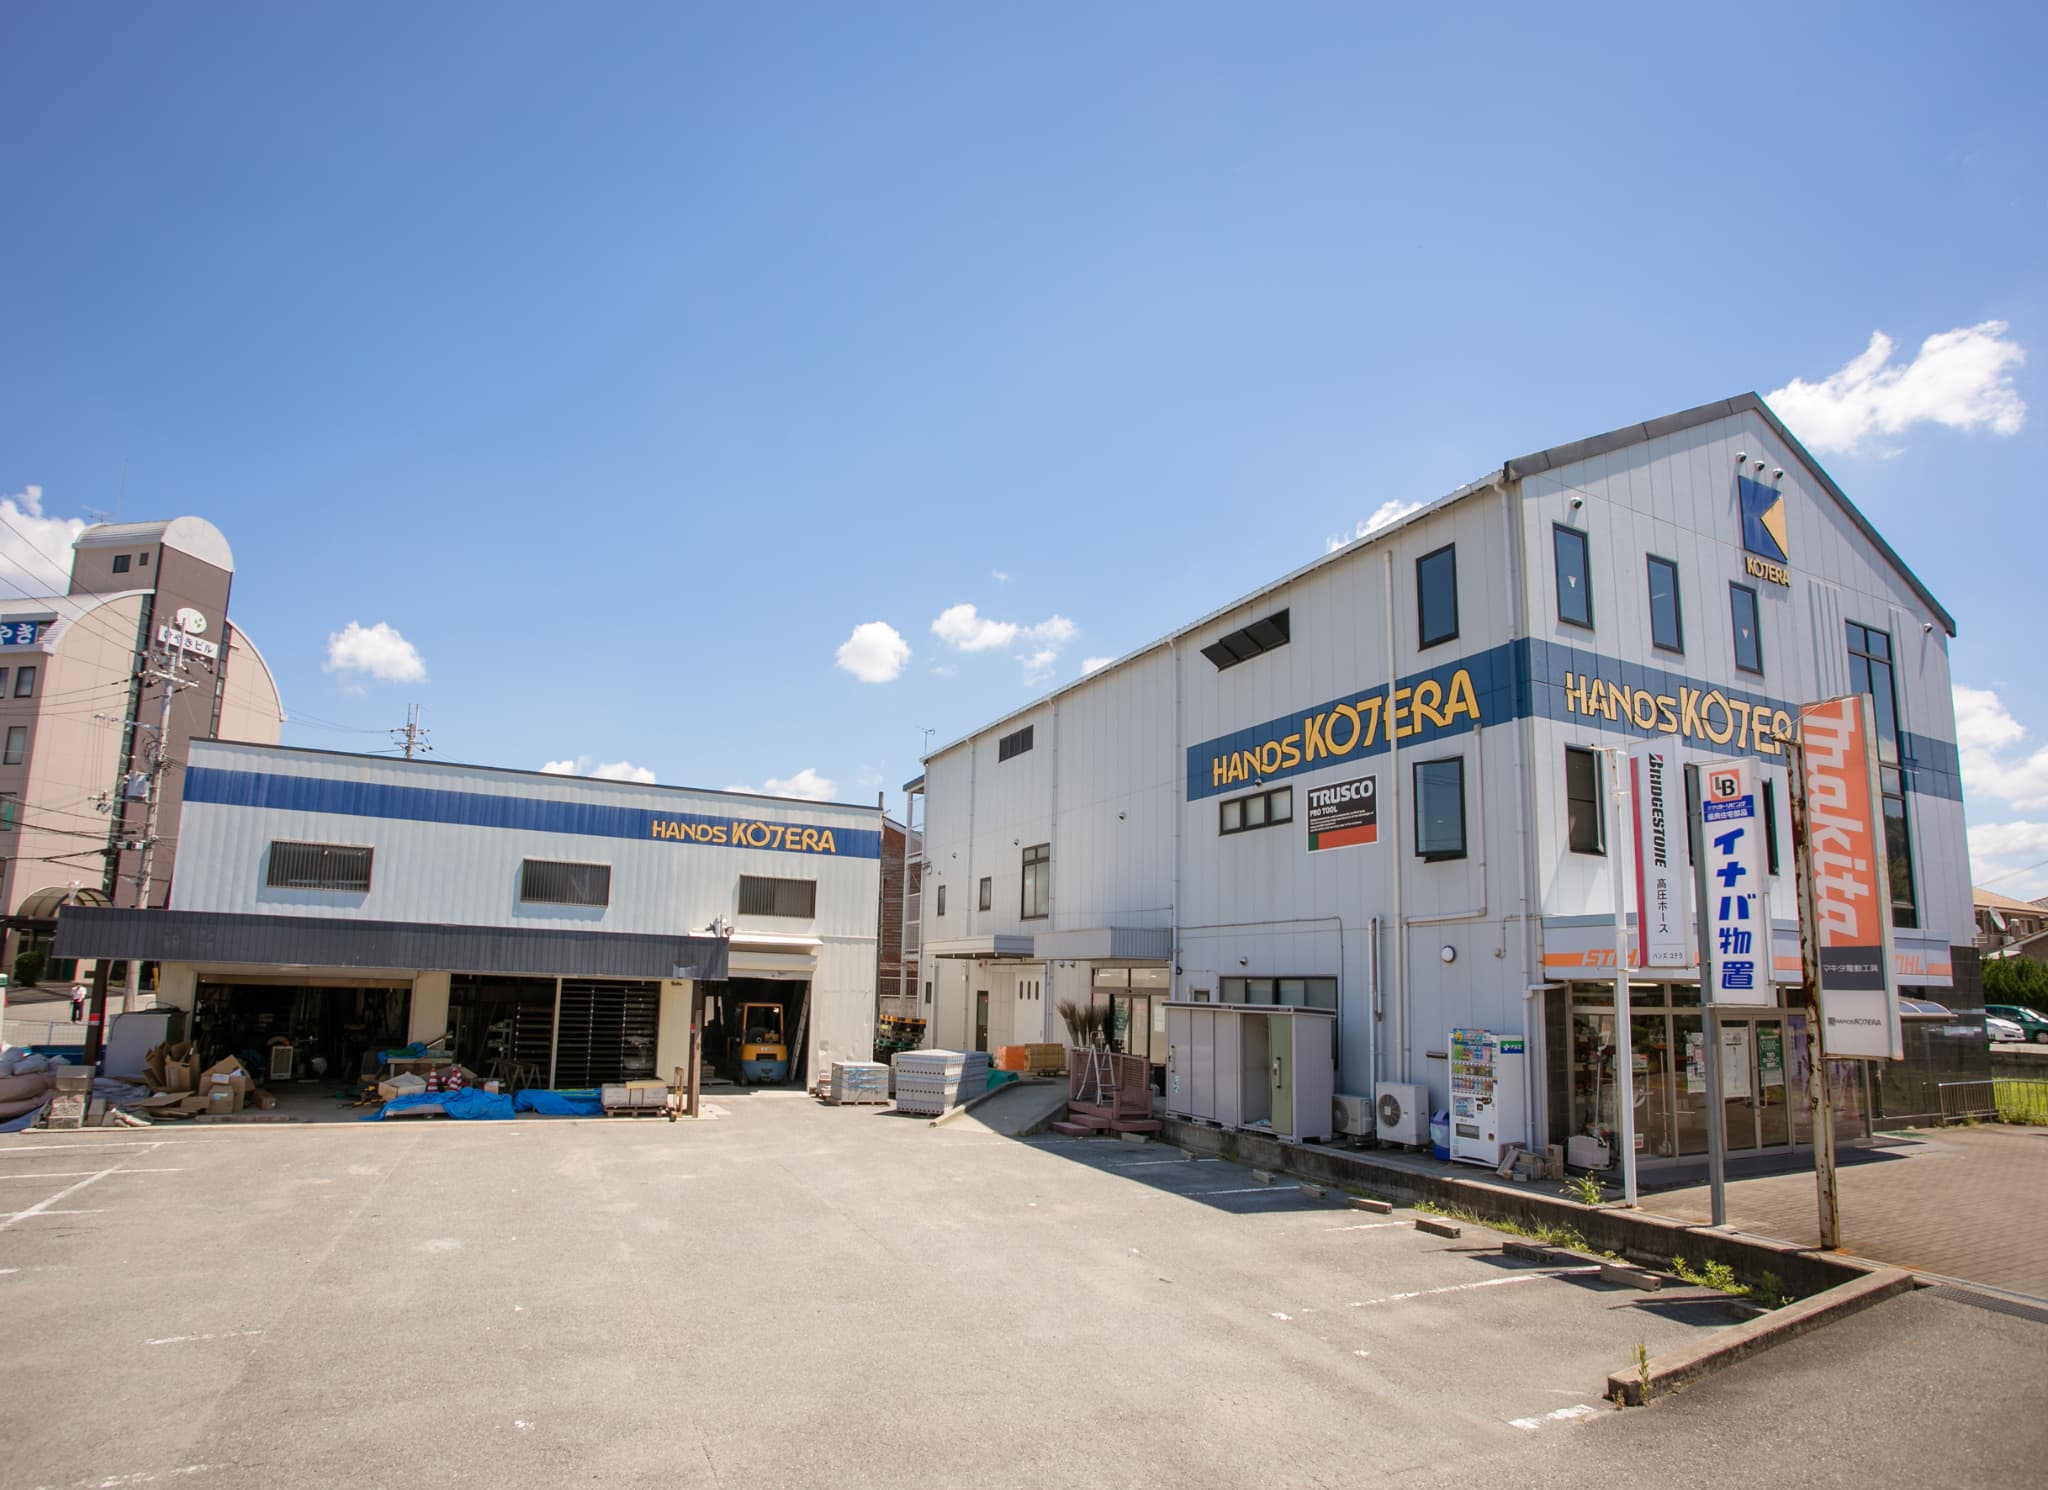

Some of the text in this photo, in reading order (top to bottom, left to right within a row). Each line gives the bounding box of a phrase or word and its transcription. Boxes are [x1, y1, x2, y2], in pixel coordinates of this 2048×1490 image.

[1745, 556, 1791, 587] KOTERA
[1212, 668, 1481, 787] HANDS KOTERA
[1565, 671, 1801, 755] HANDS KOTER
[1309, 780, 1374, 807] TRUSCO
[1648, 752, 1667, 868] BRIDGESTONE
[1803, 696, 1870, 948] makita
[651, 819, 836, 853] HANDS KOTERA
[1656, 878, 1669, 934] 高圧ホース
[1714, 828, 1756, 990] イナバ物置
